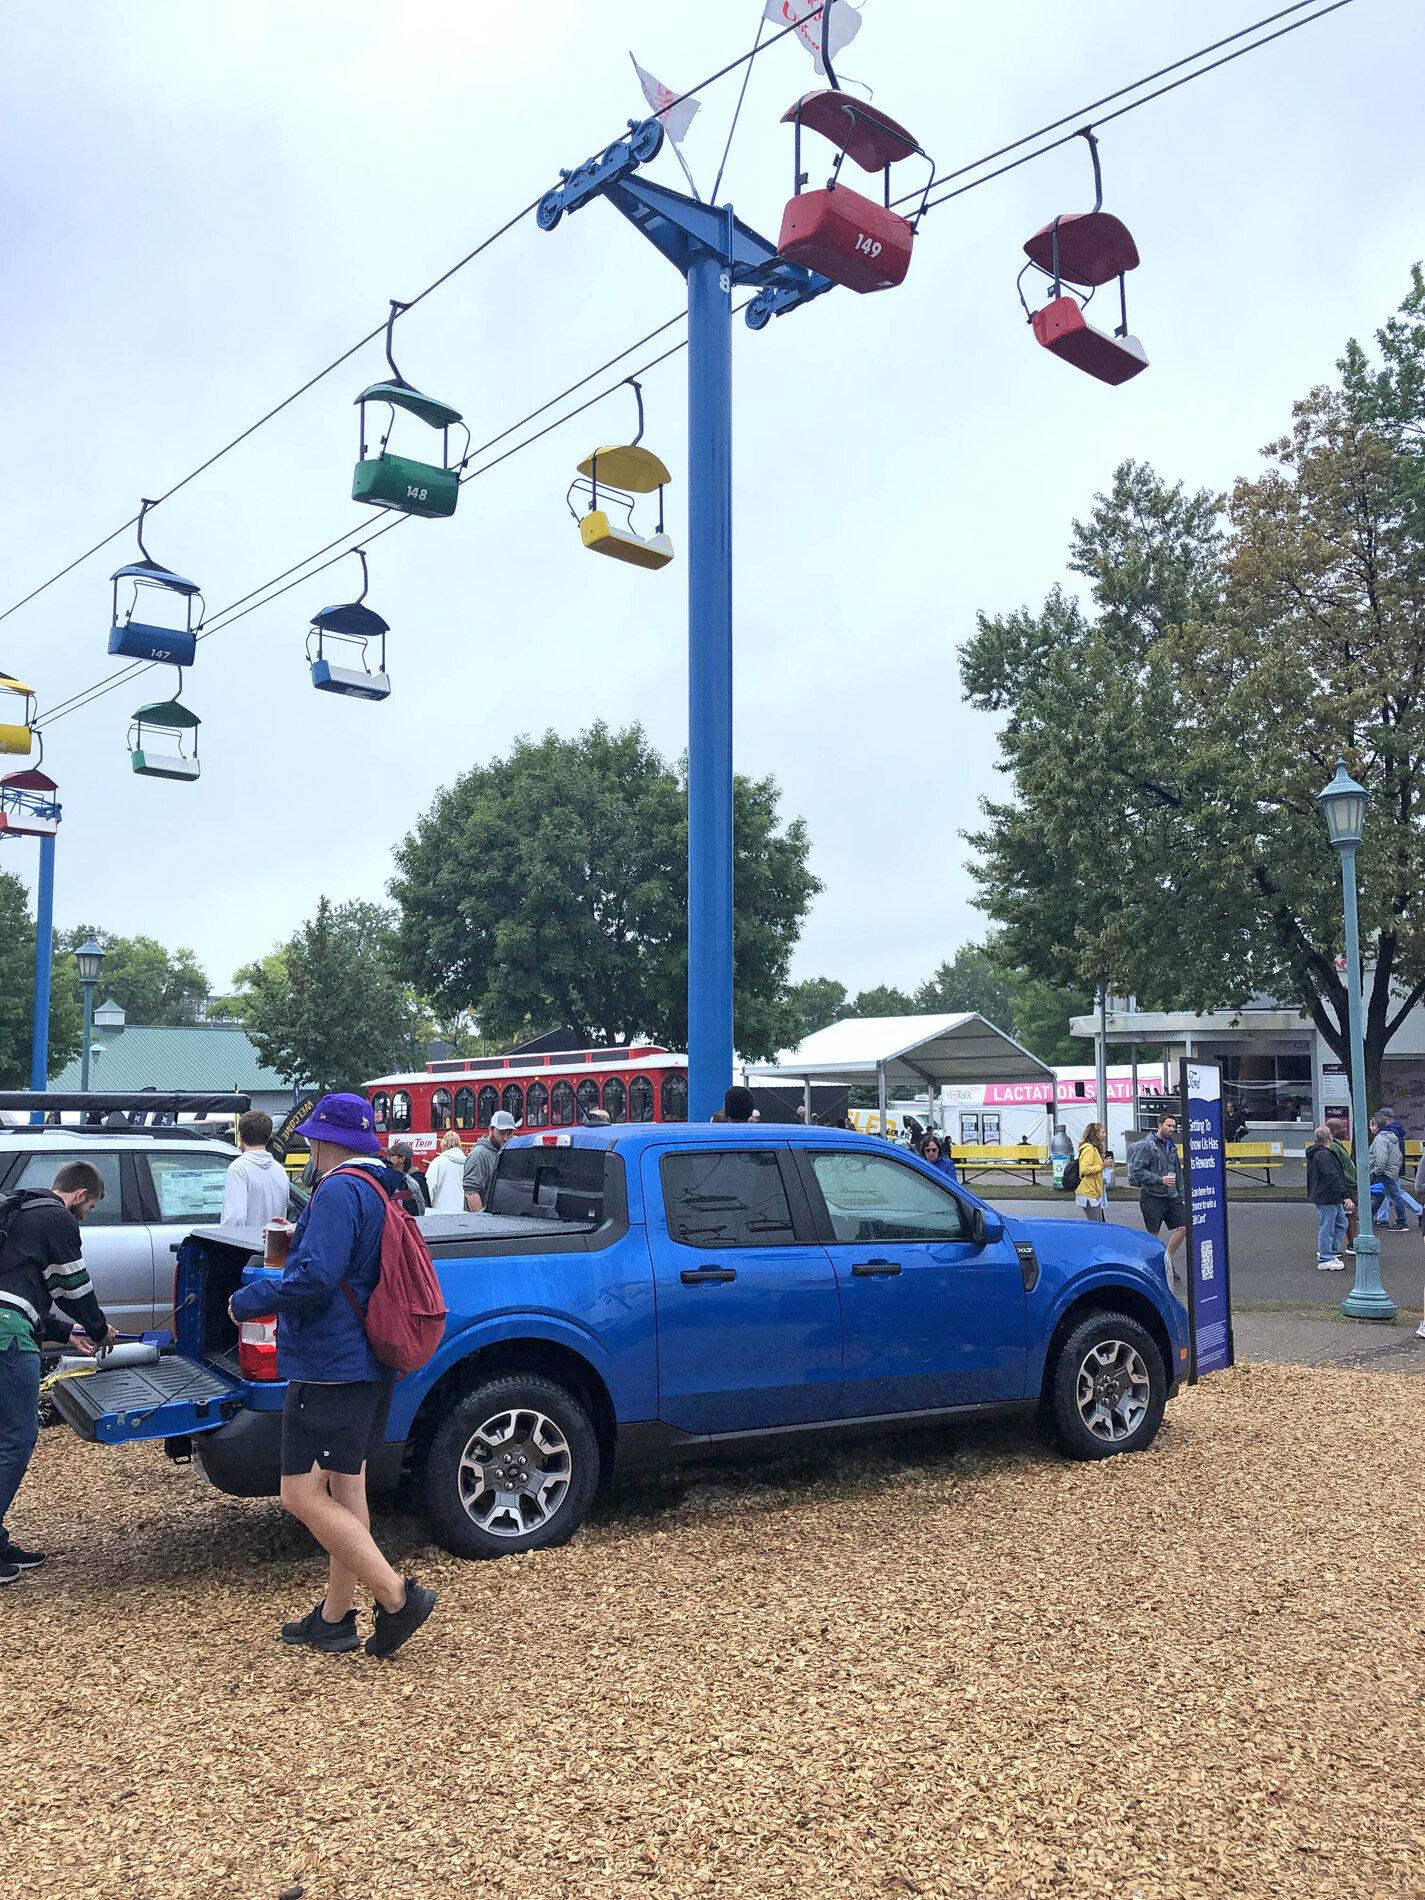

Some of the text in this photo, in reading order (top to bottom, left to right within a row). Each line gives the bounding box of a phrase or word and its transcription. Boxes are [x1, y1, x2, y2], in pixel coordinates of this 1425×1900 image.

[855, 233, 882, 258] 149
[719, 273, 731, 294] 8
[407, 485, 428, 500] 148
[150, 648, 172, 660] 147
[993, 1085, 1076, 1101] LACTATON
[280, 1100, 314, 1142] WELCOME
